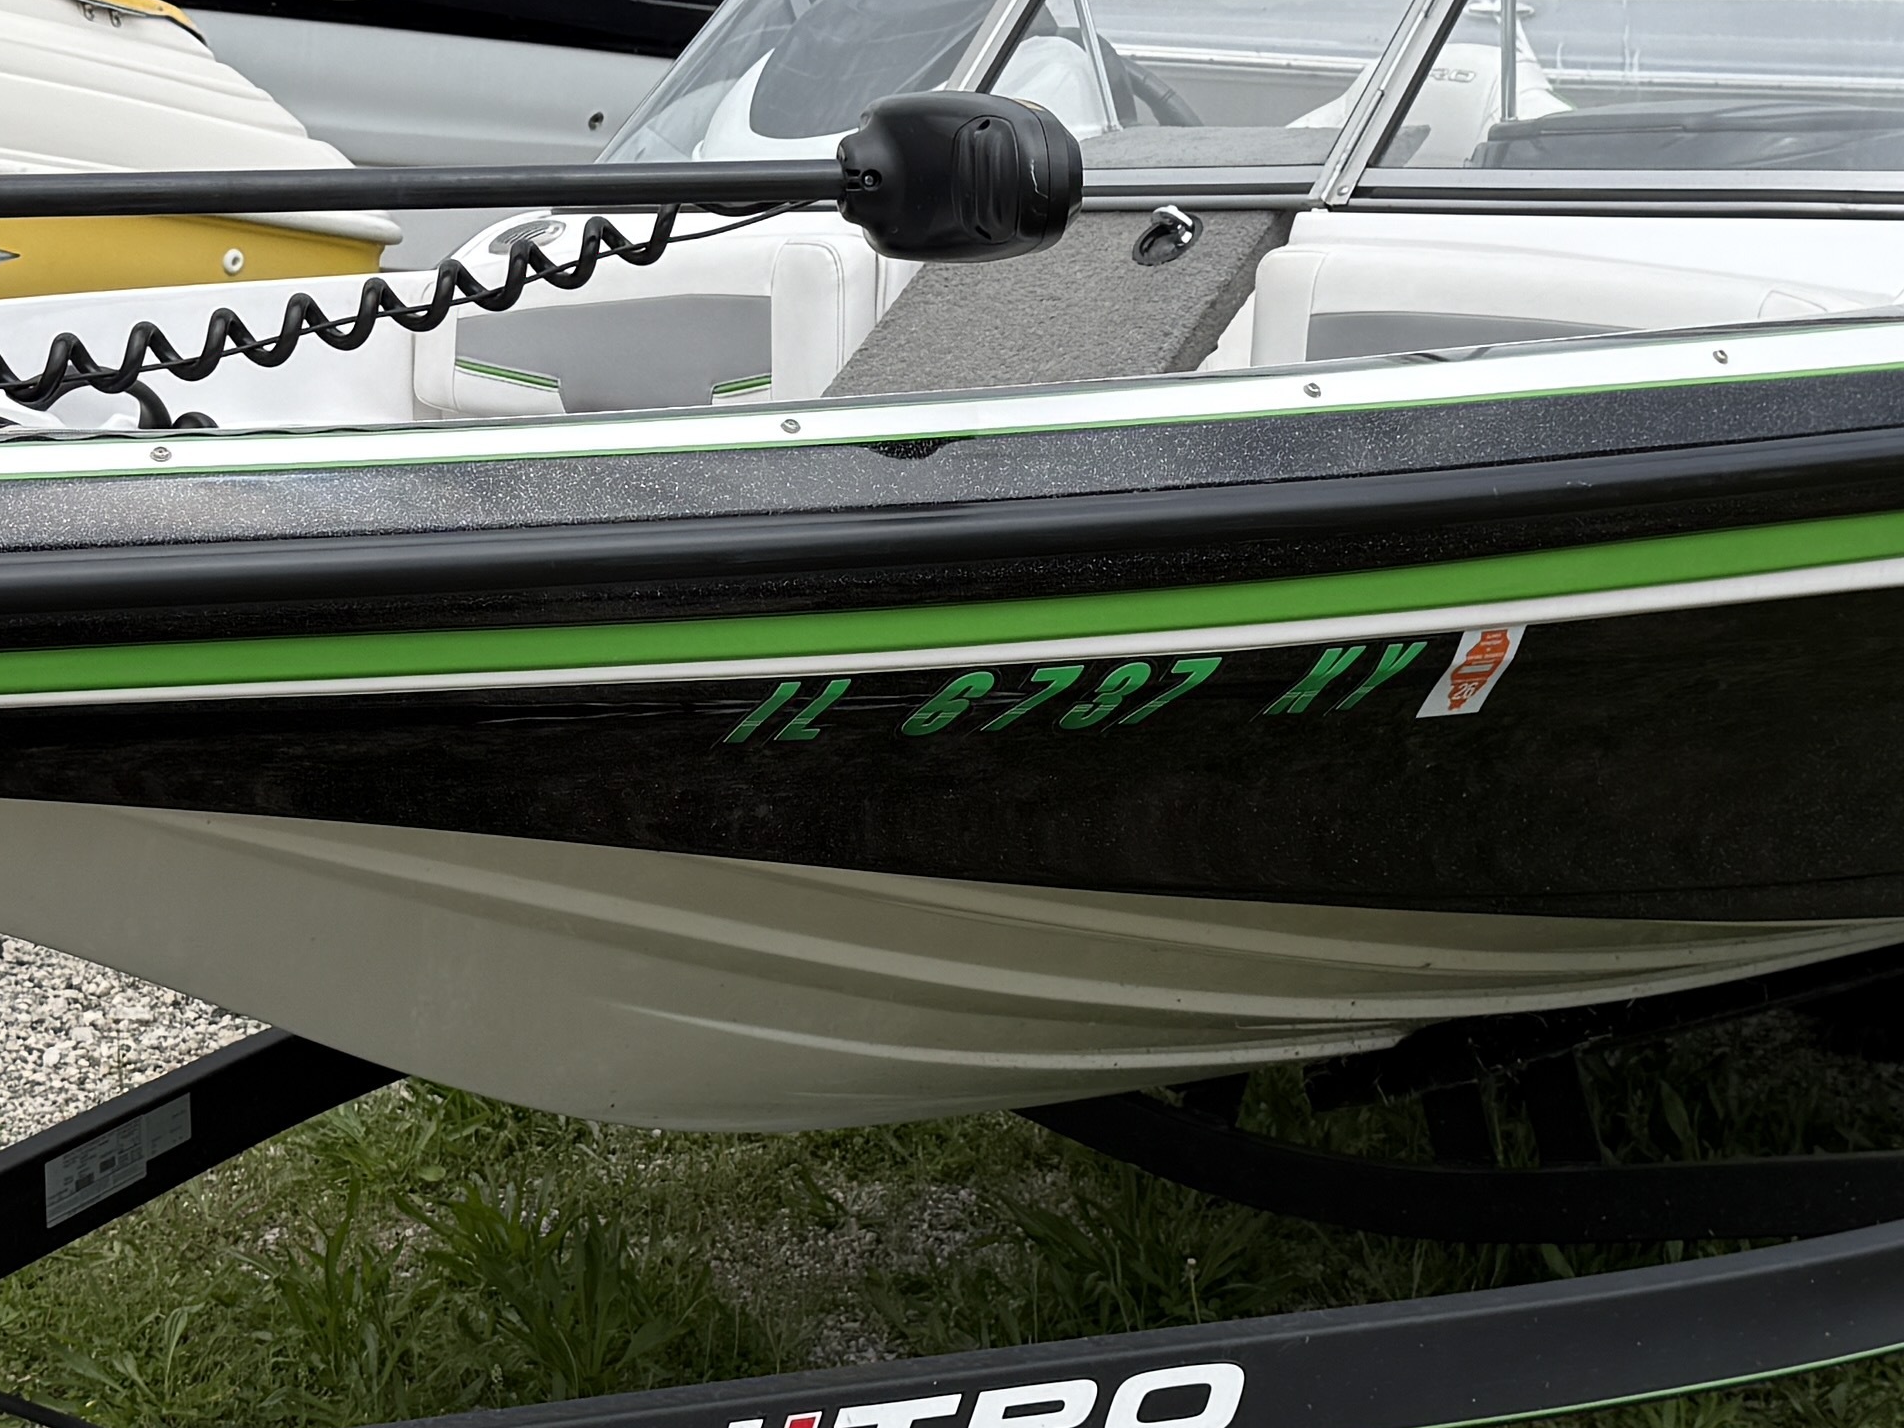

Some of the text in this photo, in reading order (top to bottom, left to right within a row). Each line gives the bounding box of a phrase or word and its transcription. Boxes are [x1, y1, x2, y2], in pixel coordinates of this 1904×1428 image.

[722, 678, 851, 744] IL
[900, 656, 1223, 736] 6737
[1262, 641, 1429, 716] XY
[1451, 681, 1479, 701] 26
